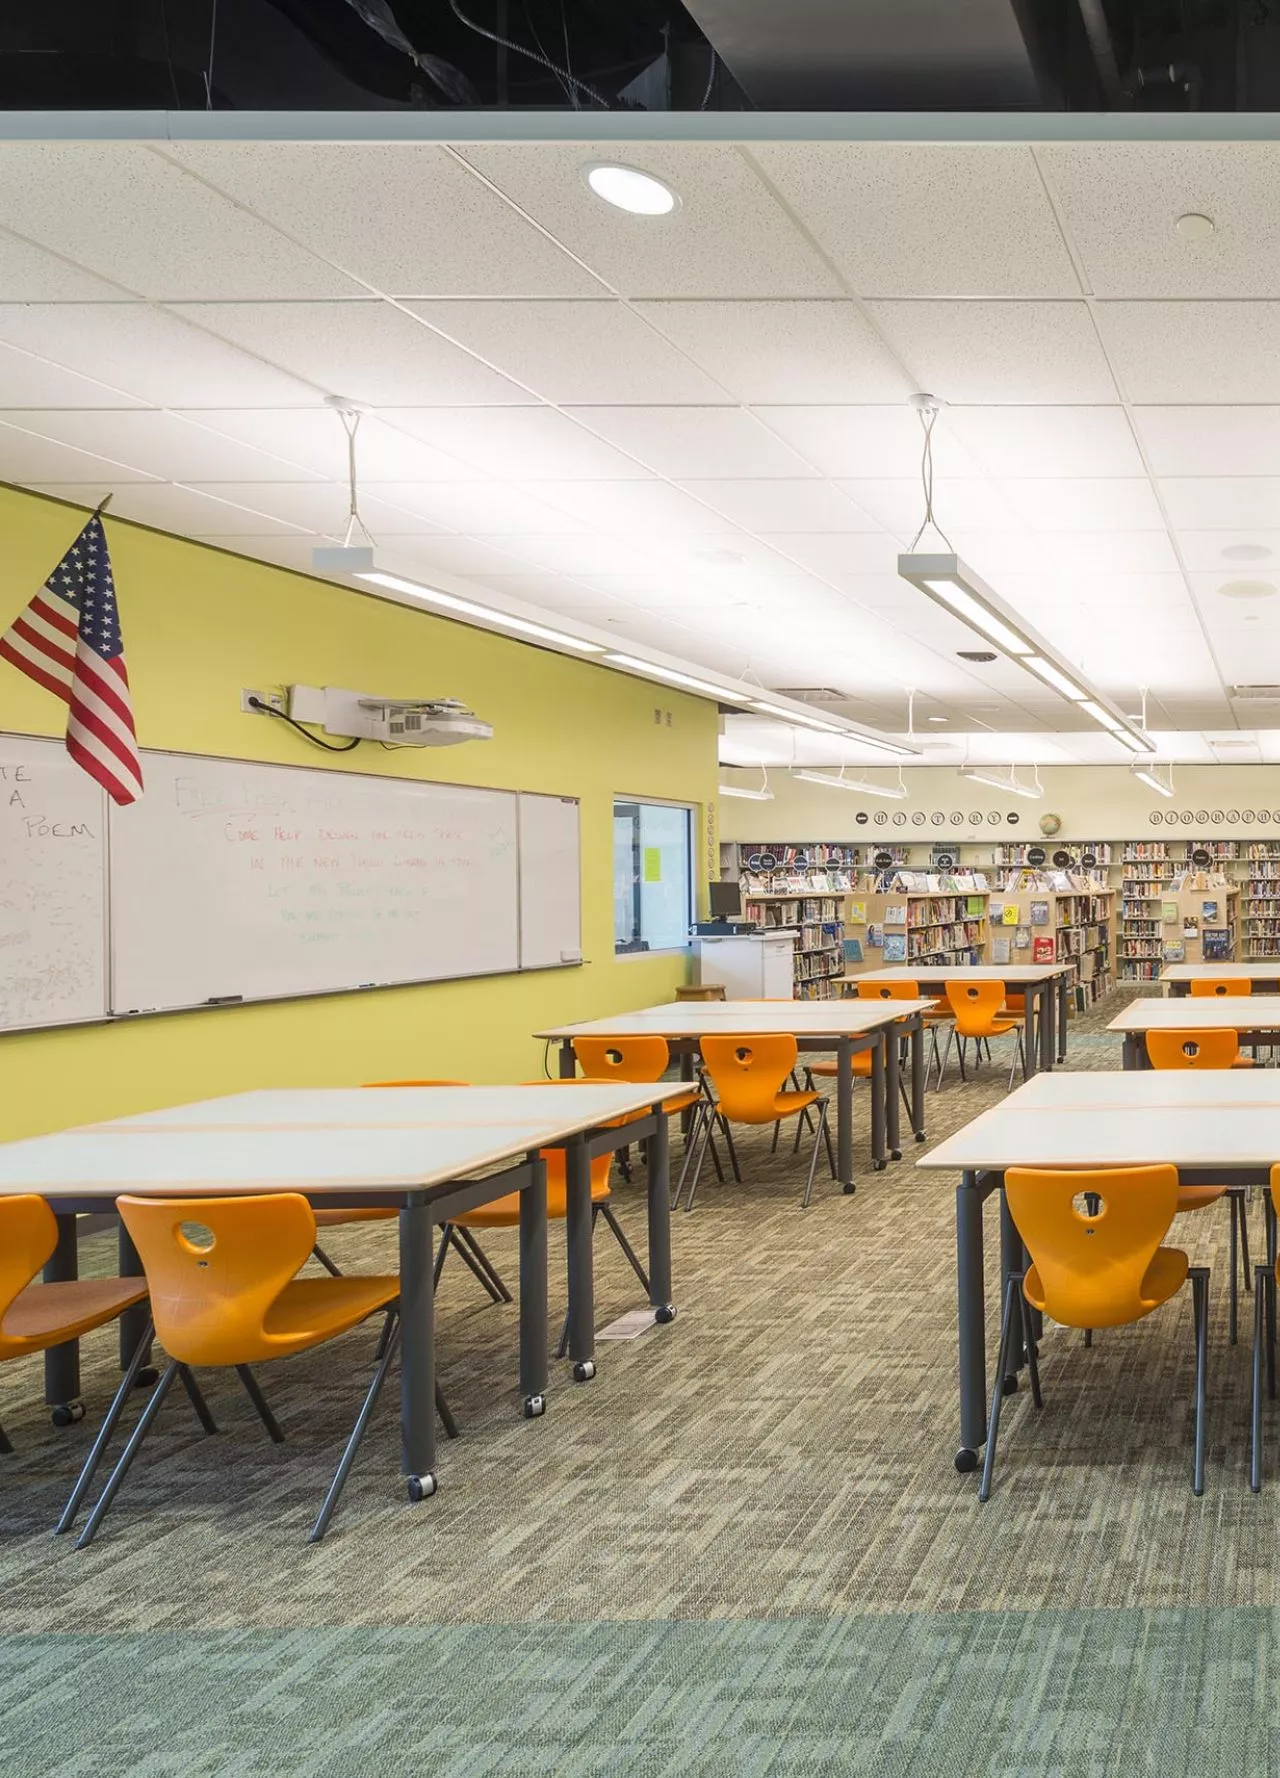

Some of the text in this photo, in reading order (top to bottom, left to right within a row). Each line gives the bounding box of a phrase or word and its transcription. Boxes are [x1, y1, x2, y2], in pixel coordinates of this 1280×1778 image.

[9, 789, 26, 808] A
[22, 814, 95, 839] POEM
[875, 812, 999, 824] HISTORY
